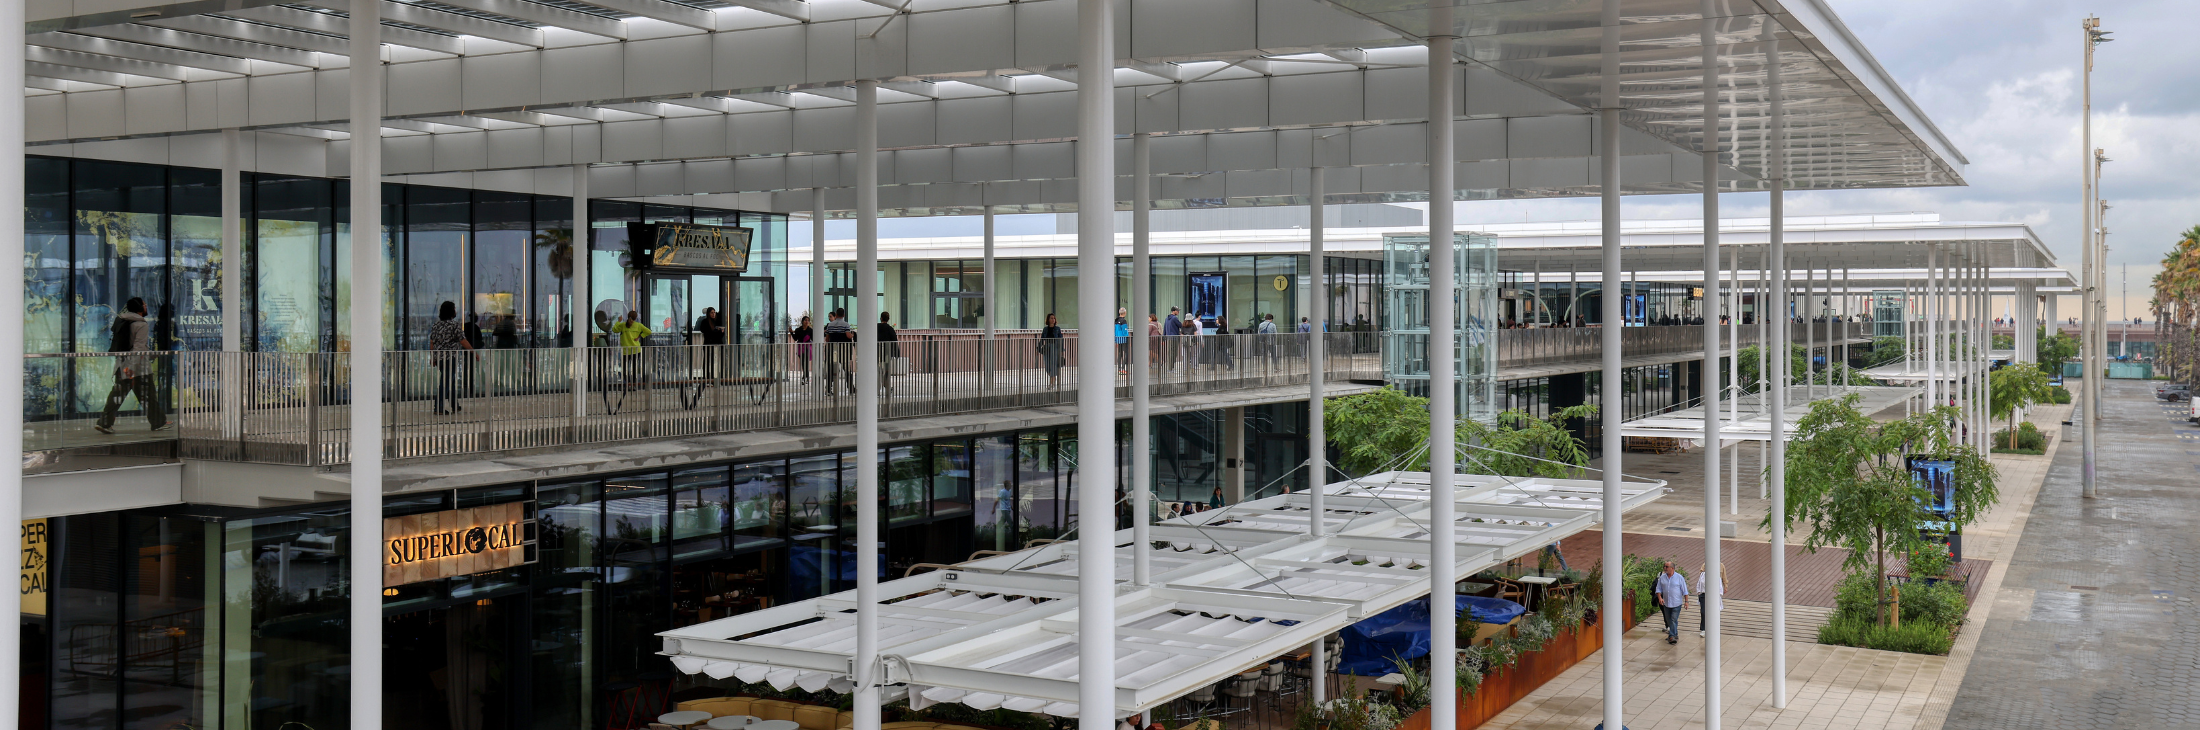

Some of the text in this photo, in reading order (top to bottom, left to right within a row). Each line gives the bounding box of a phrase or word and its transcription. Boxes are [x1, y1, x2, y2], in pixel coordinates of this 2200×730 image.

[675, 234, 729, 249] KRESALA
[191, 279, 218, 311] K
[180, 315, 223, 325] KRESAL
[21, 522, 47, 545] PER
[20, 572, 46, 595] CAL
